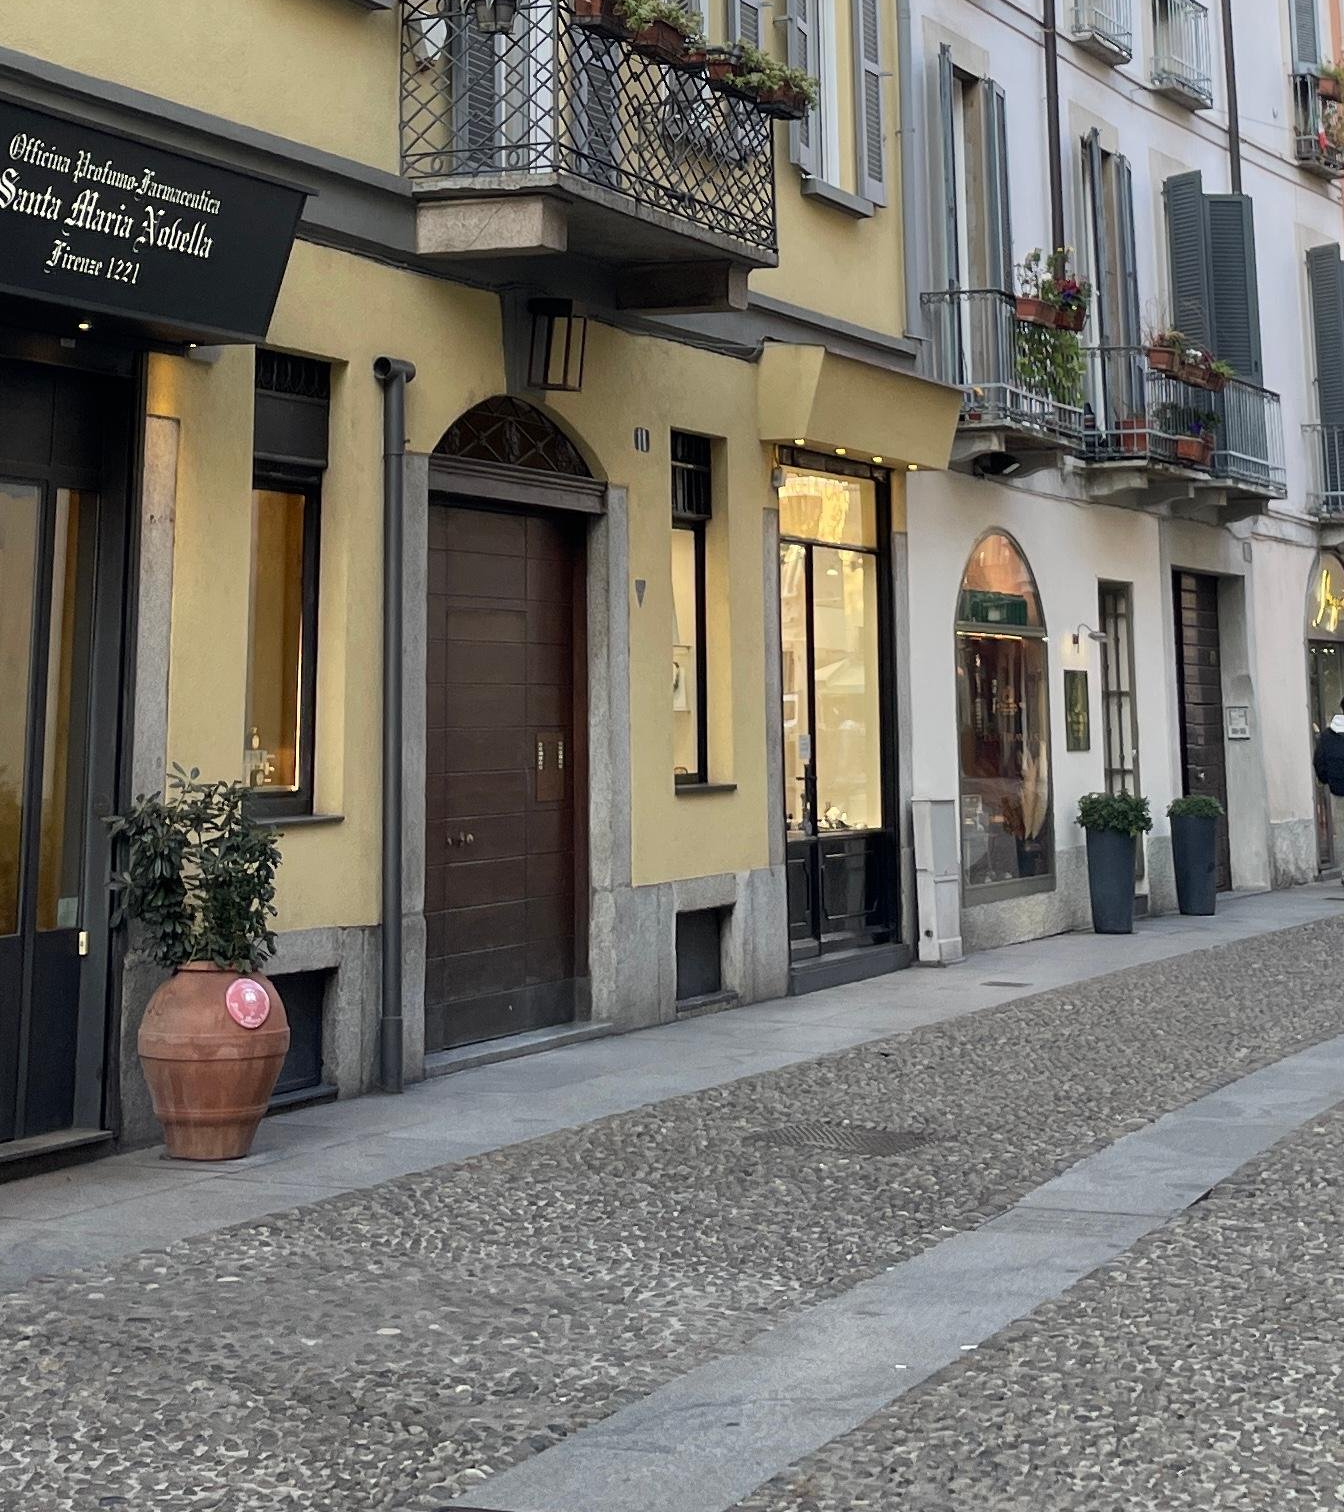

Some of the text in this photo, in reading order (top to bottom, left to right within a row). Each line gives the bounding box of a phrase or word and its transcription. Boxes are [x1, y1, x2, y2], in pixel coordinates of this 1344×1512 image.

[9, 133, 71, 173] Officina
[61, 189, 134, 237] Maria
[133, 205, 213, 259] Novella
[44, 239, 140, 284] Firenze 1221
